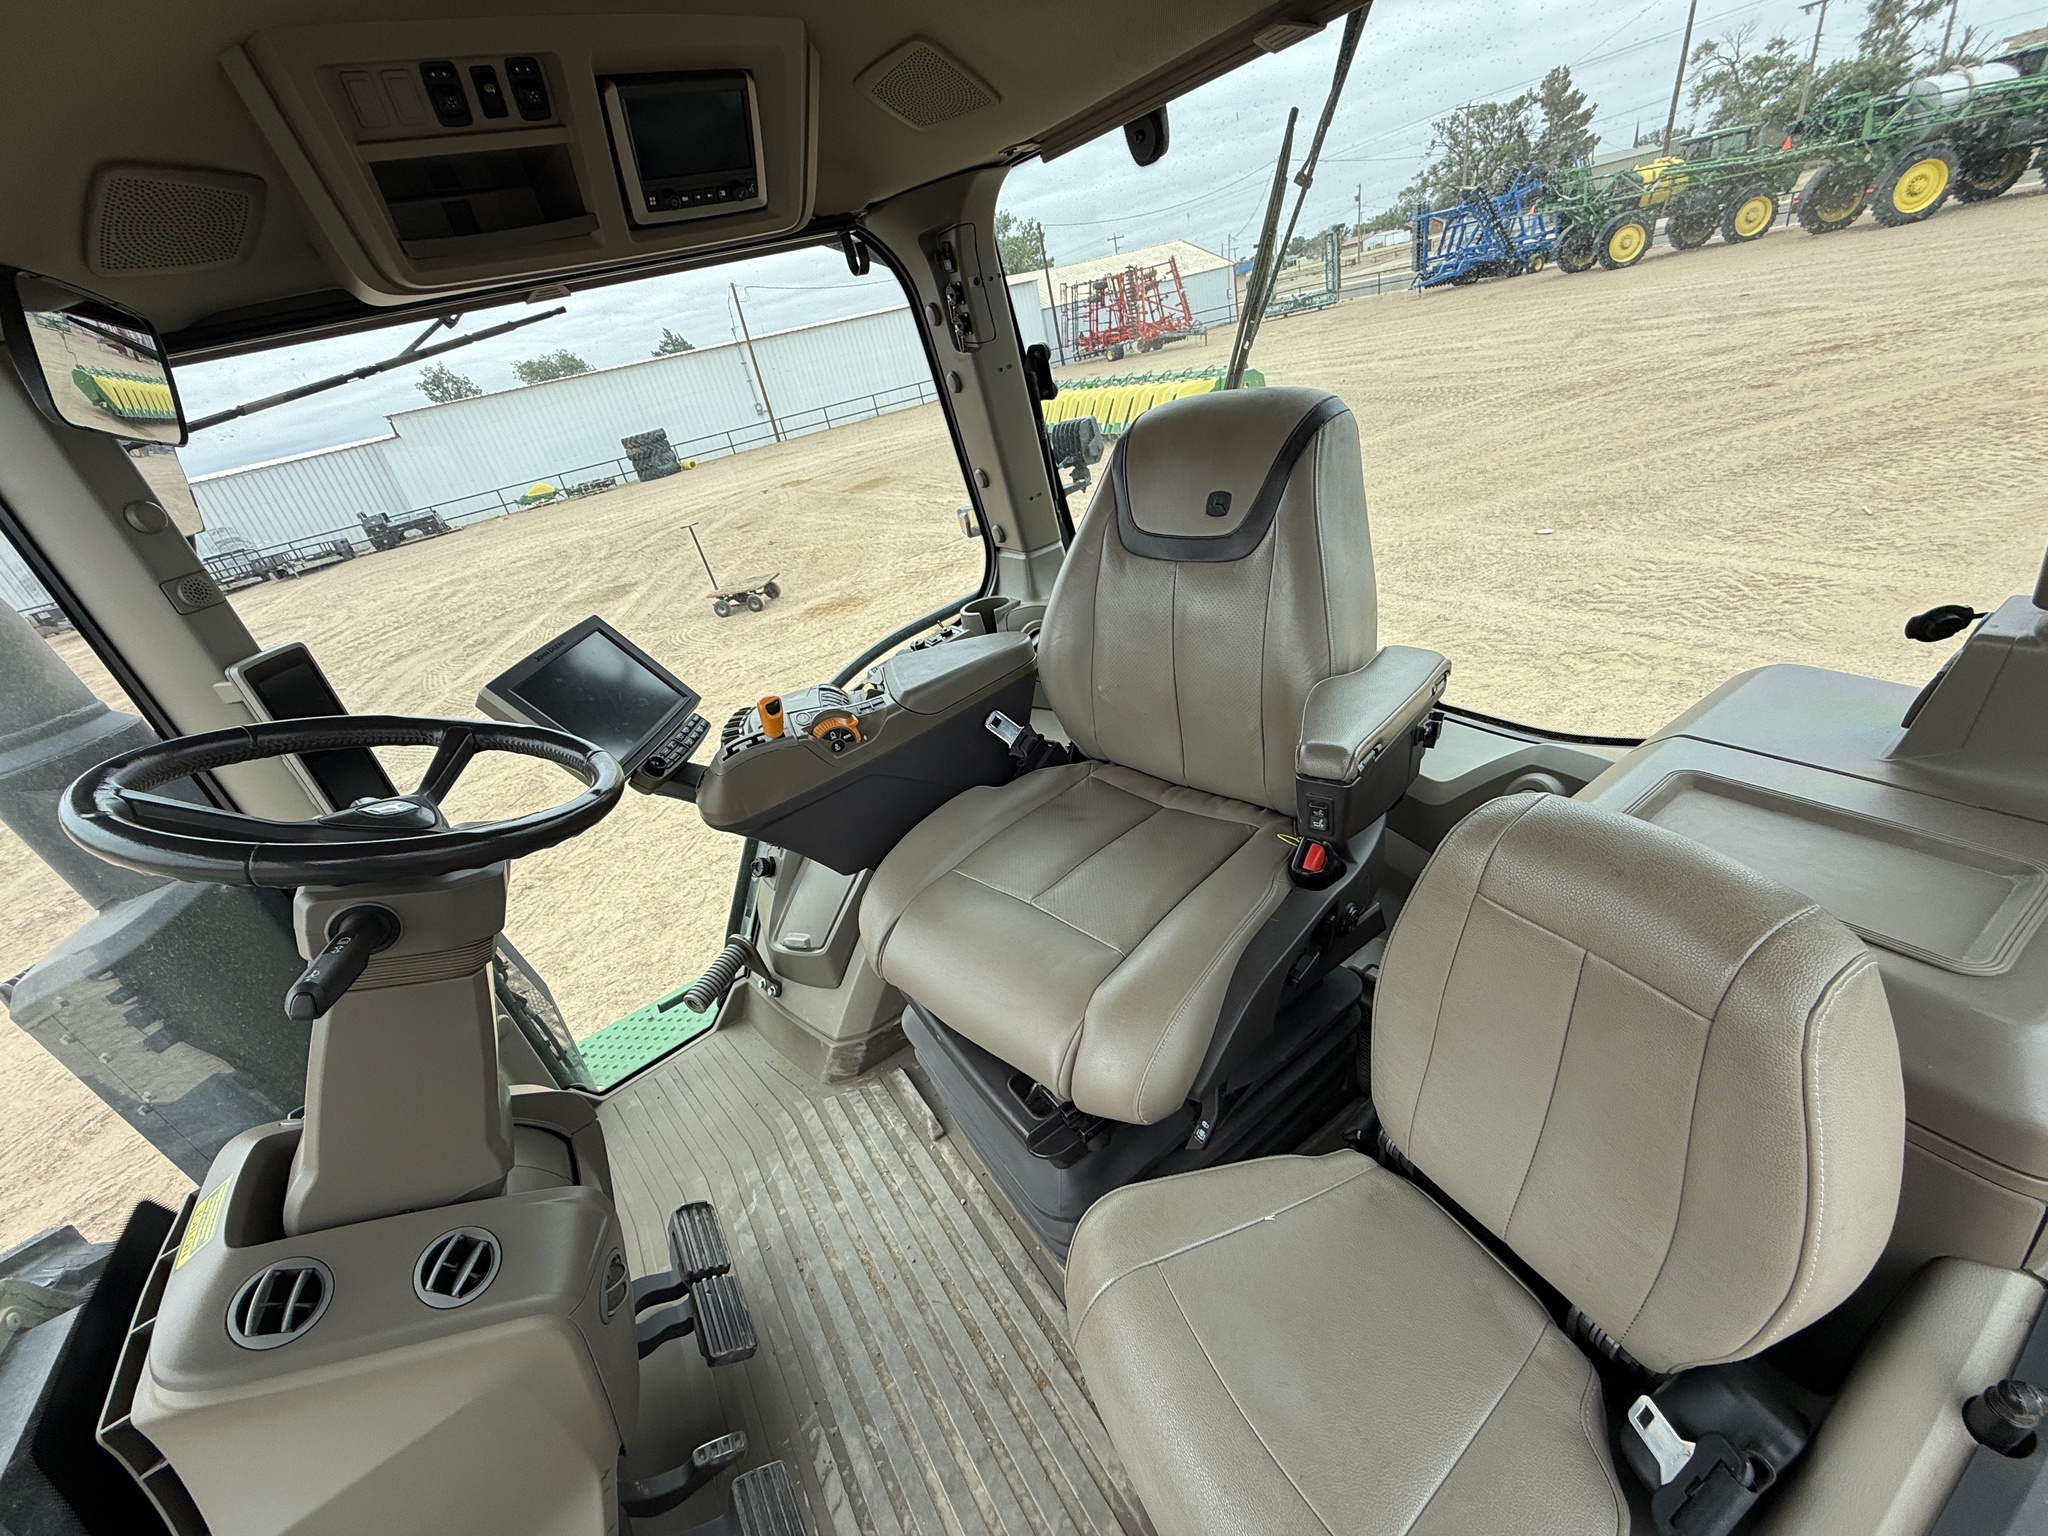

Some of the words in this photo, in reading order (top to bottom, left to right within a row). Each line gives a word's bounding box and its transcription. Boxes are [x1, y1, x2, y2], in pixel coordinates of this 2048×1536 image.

[534, 650, 550, 662] JOHN
[548, 640, 566, 653] DEERE
[181, 1206, 205, 1259] NOTICE
